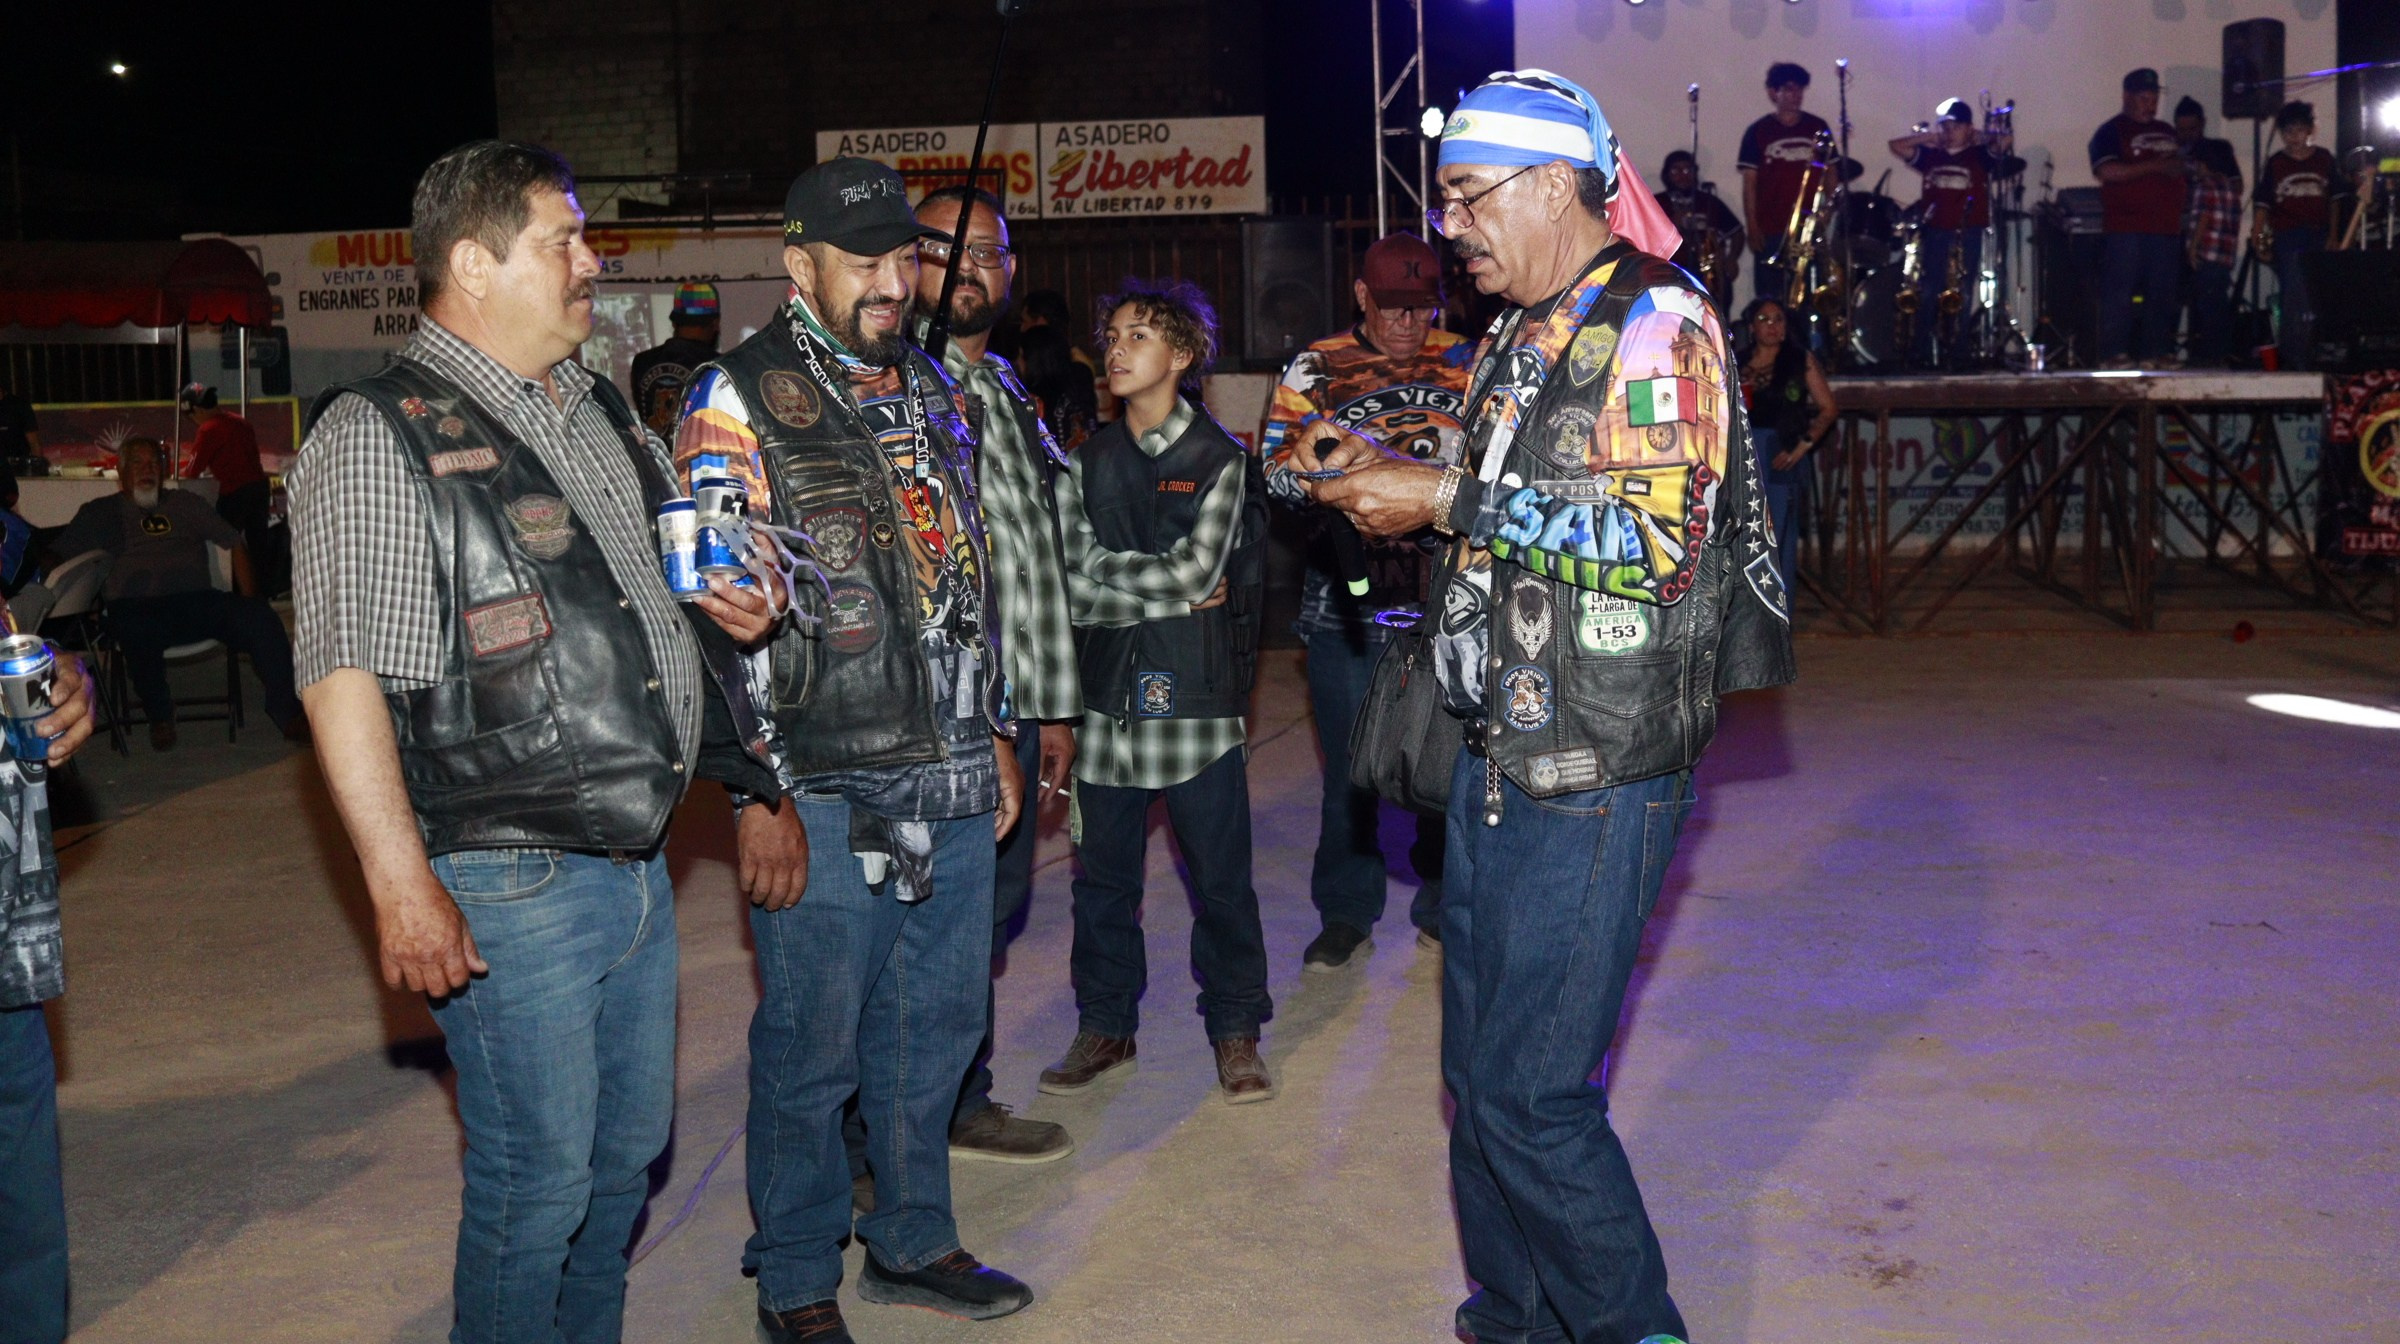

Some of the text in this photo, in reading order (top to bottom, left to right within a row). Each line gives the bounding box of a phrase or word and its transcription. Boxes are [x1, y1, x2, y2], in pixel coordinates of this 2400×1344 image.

[838, 131, 946, 155] ASADERO
[1055, 123, 1170, 148] ASADERO
[1048, 144, 1253, 200] Libertad
[1053, 200, 1076, 214] AV.
[1083, 196, 1165, 213] LIBERTAD
[337, 231, 416, 269] MUL
[322, 269, 405, 285] VENTA DE
[299, 286, 421, 312] ENGRANES PAR
[373, 313, 419, 336] ARRA
[1582, 330, 1614, 344] AMIGO
[1398, 388, 1463, 419] VIEJ
[1571, 485, 1594, 495] POS
[2347, 532, 2400, 550] TIJU
[1585, 614, 1641, 627] AMERICA
